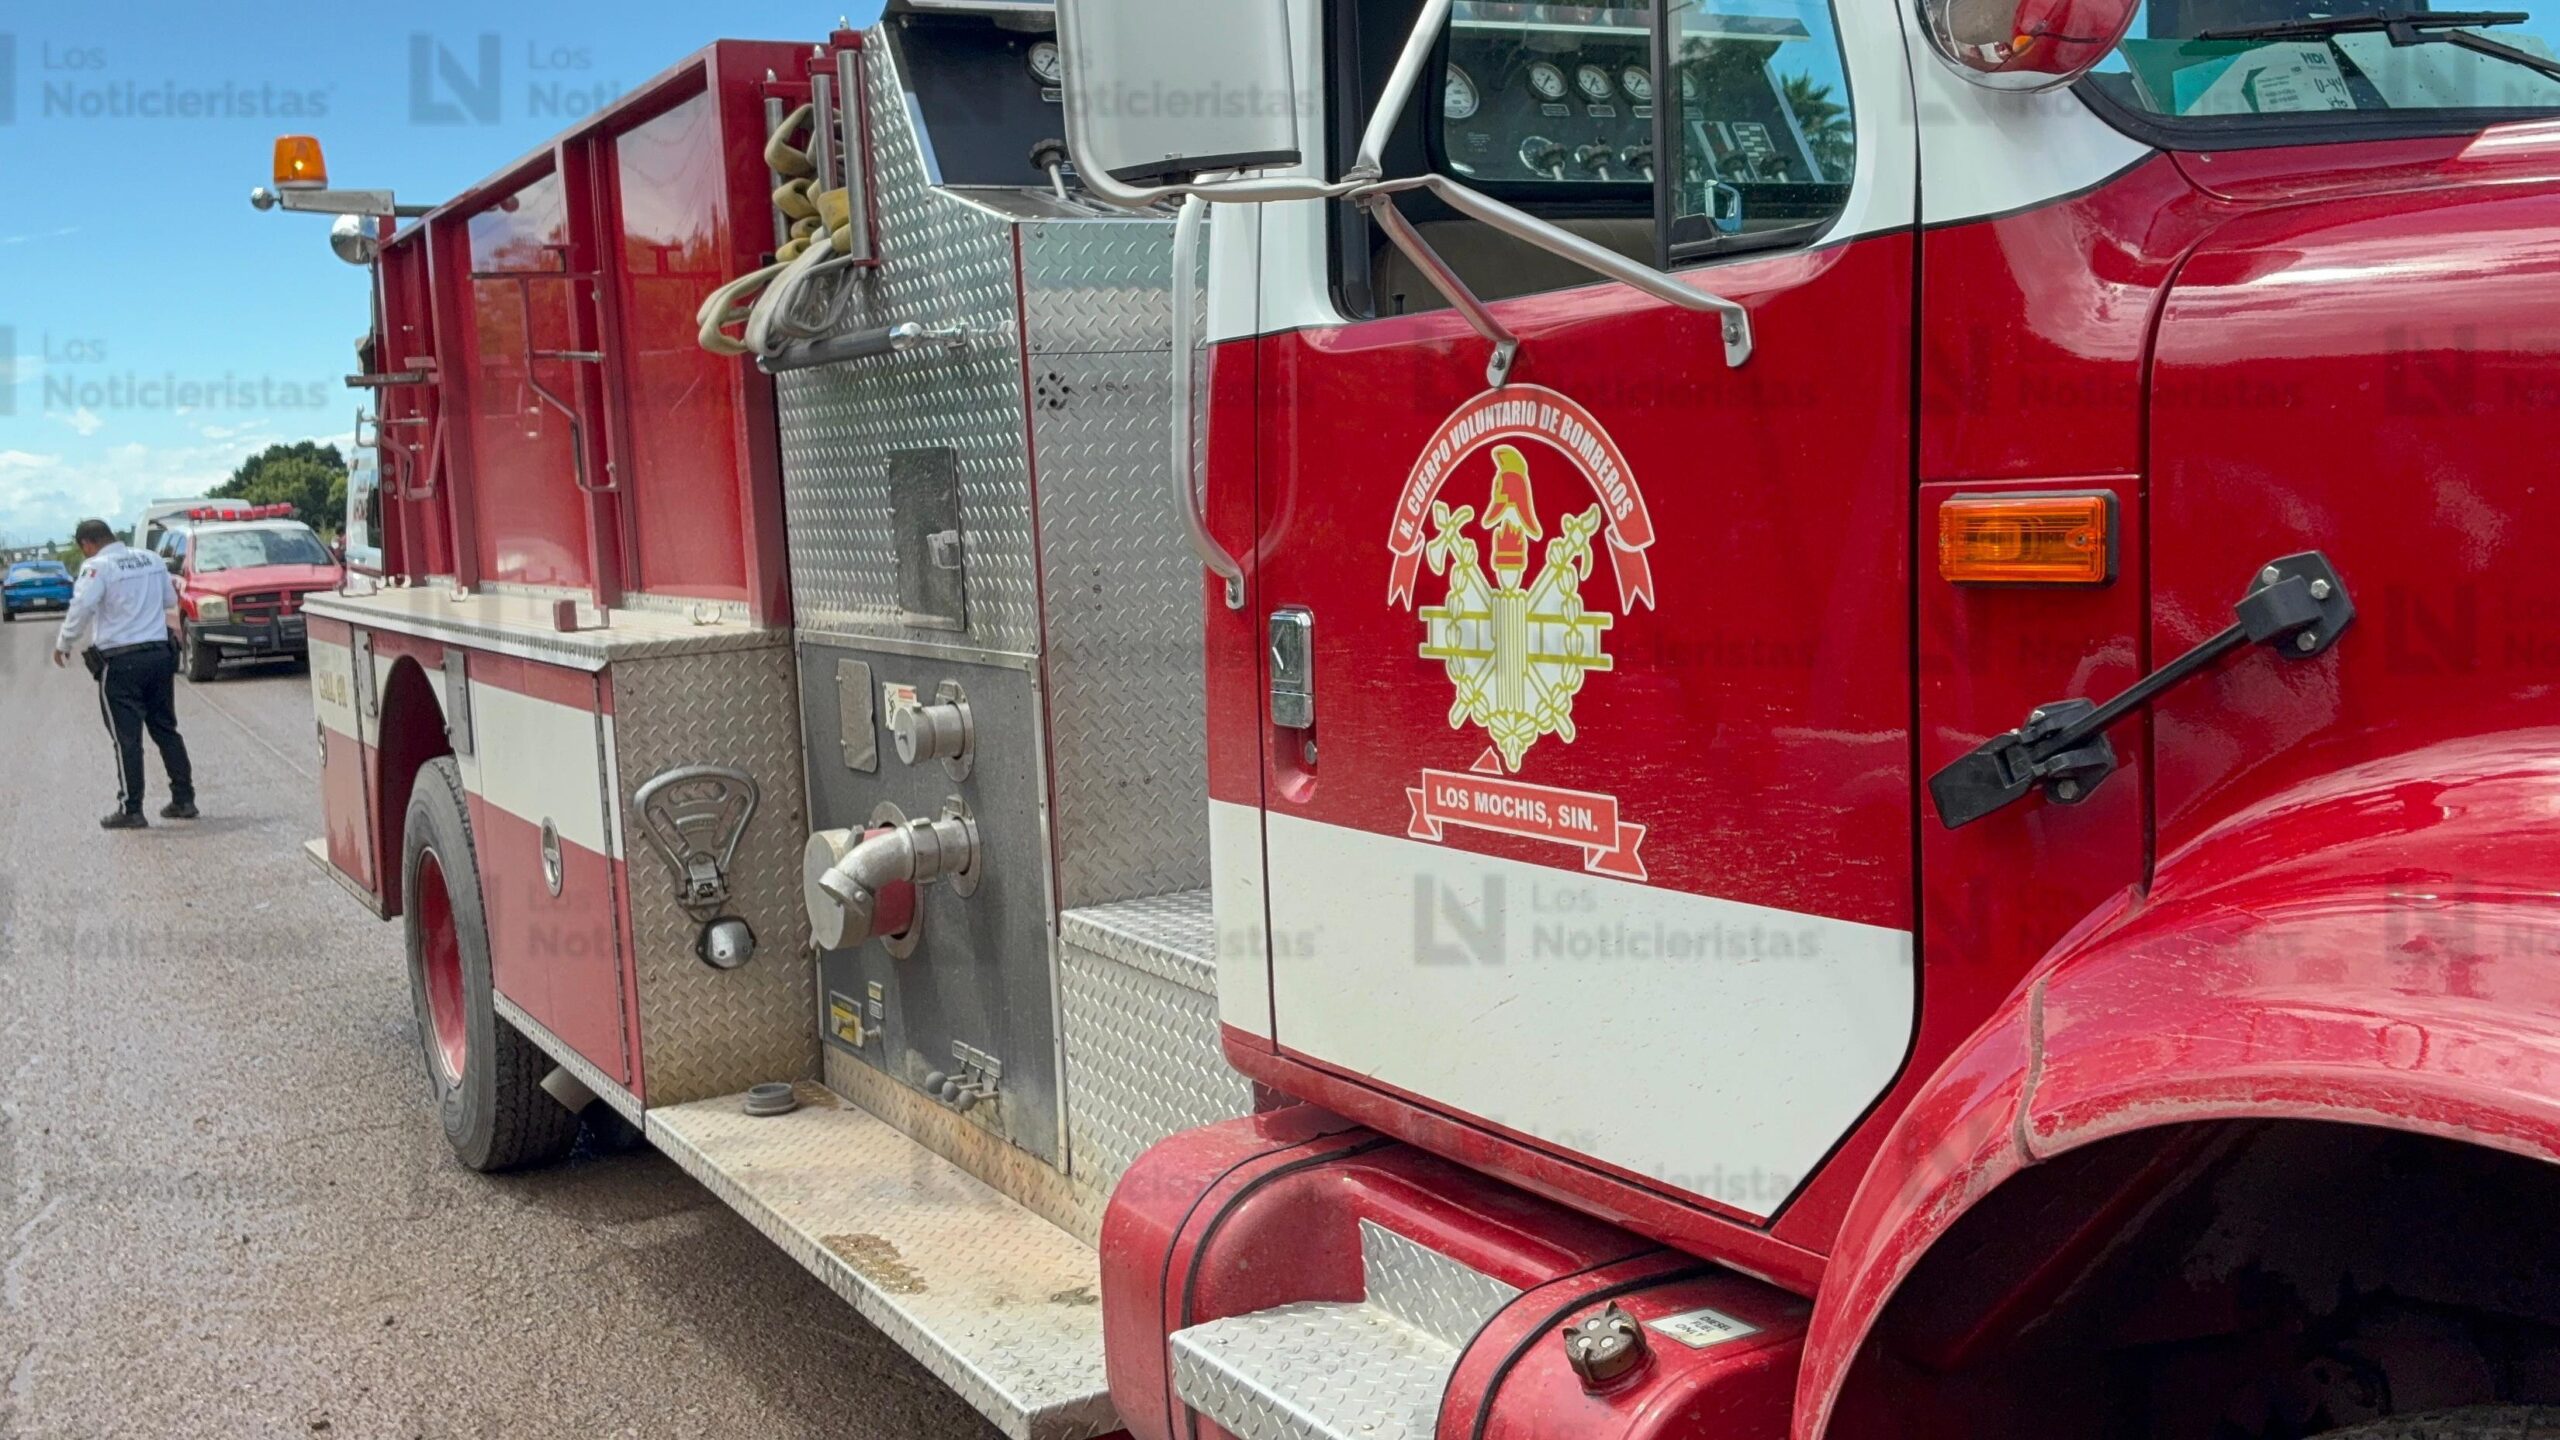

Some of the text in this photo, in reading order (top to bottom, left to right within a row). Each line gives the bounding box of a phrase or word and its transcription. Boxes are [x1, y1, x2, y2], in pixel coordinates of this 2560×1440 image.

[1399, 400, 1635, 541] H. CUERPO VOLUNTARIO DE BOMBEROS
[1436, 785, 1599, 833] LOS MOCHIS, SIN.
[1676, 1323, 1704, 1336] ONLY
[1691, 1320, 1714, 1332] FUEL
[1700, 1316, 1732, 1331] DIESEL
